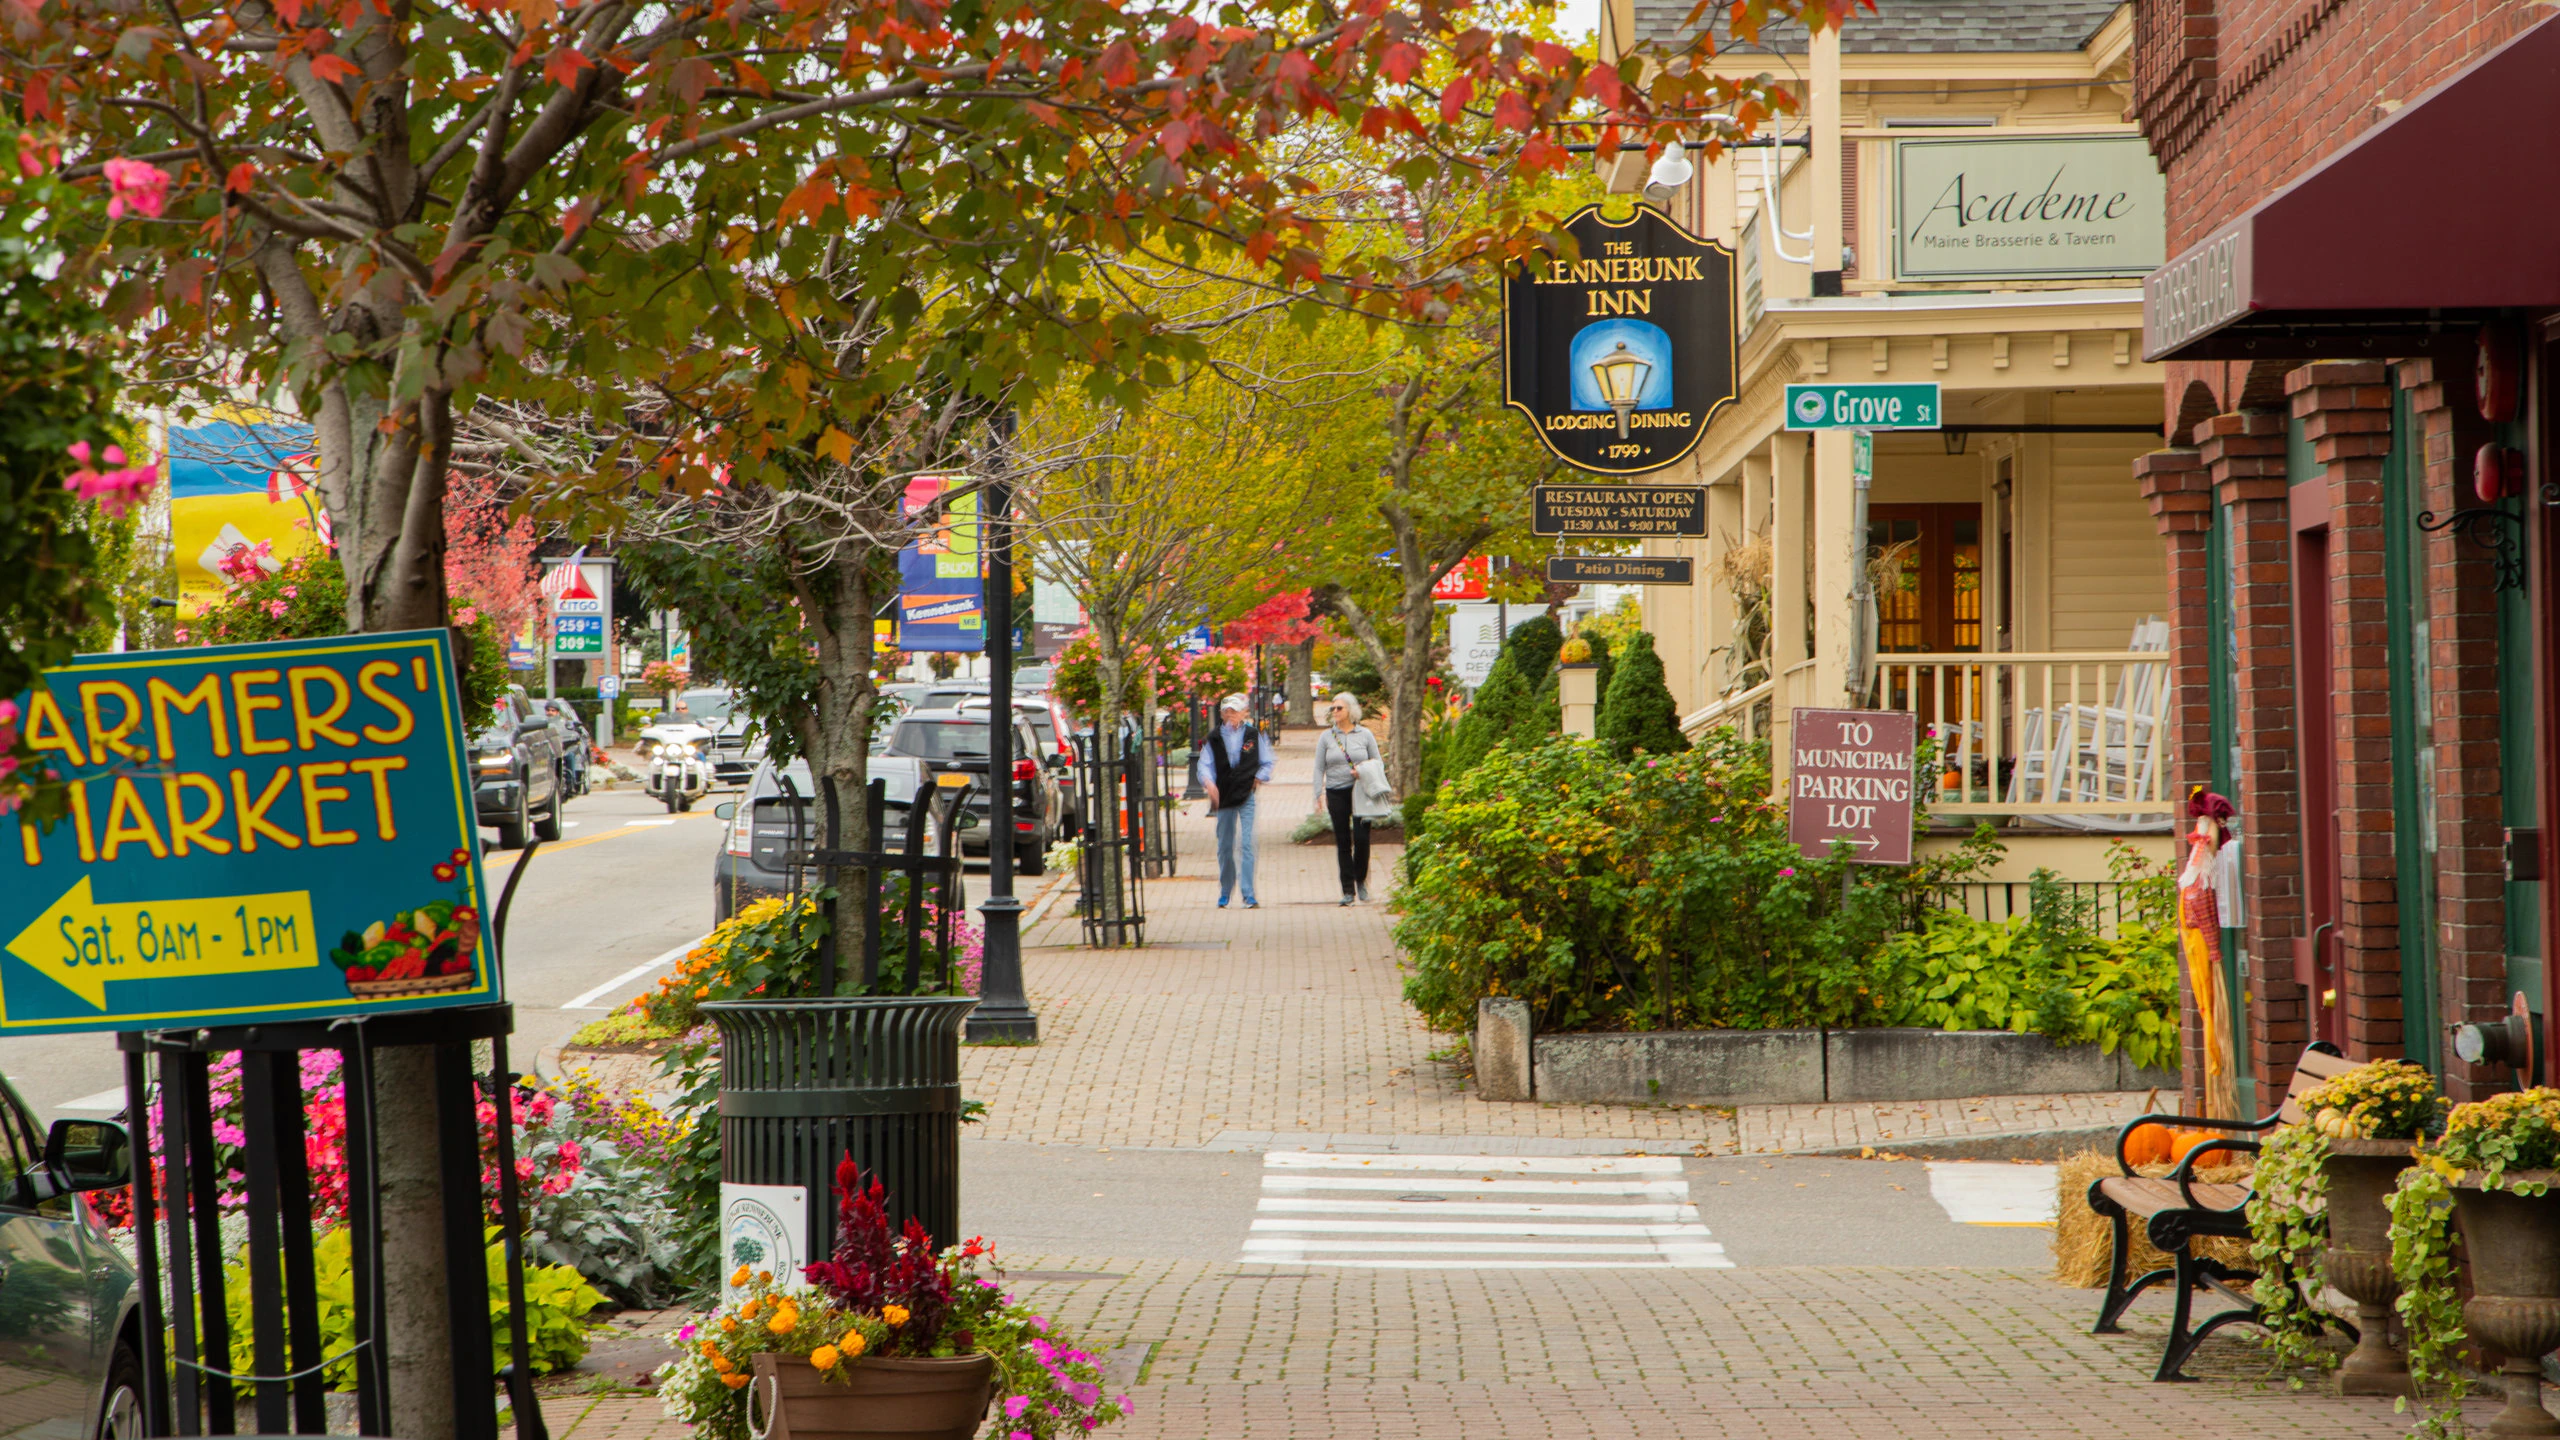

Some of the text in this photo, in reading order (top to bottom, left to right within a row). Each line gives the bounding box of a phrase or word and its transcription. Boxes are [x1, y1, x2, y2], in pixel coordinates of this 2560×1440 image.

[1910, 163, 2136, 244] Academe
[1603, 241, 1633, 256] THE
[1924, 232, 2116, 249] Maine Brasserie & Tavern
[1586, 289, 1652, 316] INN
[1833, 389, 1932, 424] Grove St
[1545, 412, 1692, 431] LODGING DINING
[1608, 444, 1642, 459] 1799
[1545, 490, 1696, 505] RESTAURANT OPEN
[1548, 506, 1611, 518] TUESDAY
[1620, 506, 1693, 518] SATURDAY
[1563, 520, 1593, 531] 11:30
[1595, 520, 1619, 531] AM
[1629, 521, 1653, 531] 9:00
[1656, 521, 1677, 531] PM
[1575, 563, 1665, 578] Patio Dining
[559, 600, 598, 611] CITGO
[906, 599, 975, 621] Kennebunk
[558, 619, 585, 632] 259
[558, 636, 585, 650] 309
[24, 656, 428, 767] ARMERS'
[1838, 721, 1873, 747] TO
[1797, 749, 1910, 771] MUNICIPAL
[1797, 774, 1909, 802] PARKING
[1827, 804, 1876, 829] LOT
[60, 905, 299, 967] Sat. 8AM - 1PM
